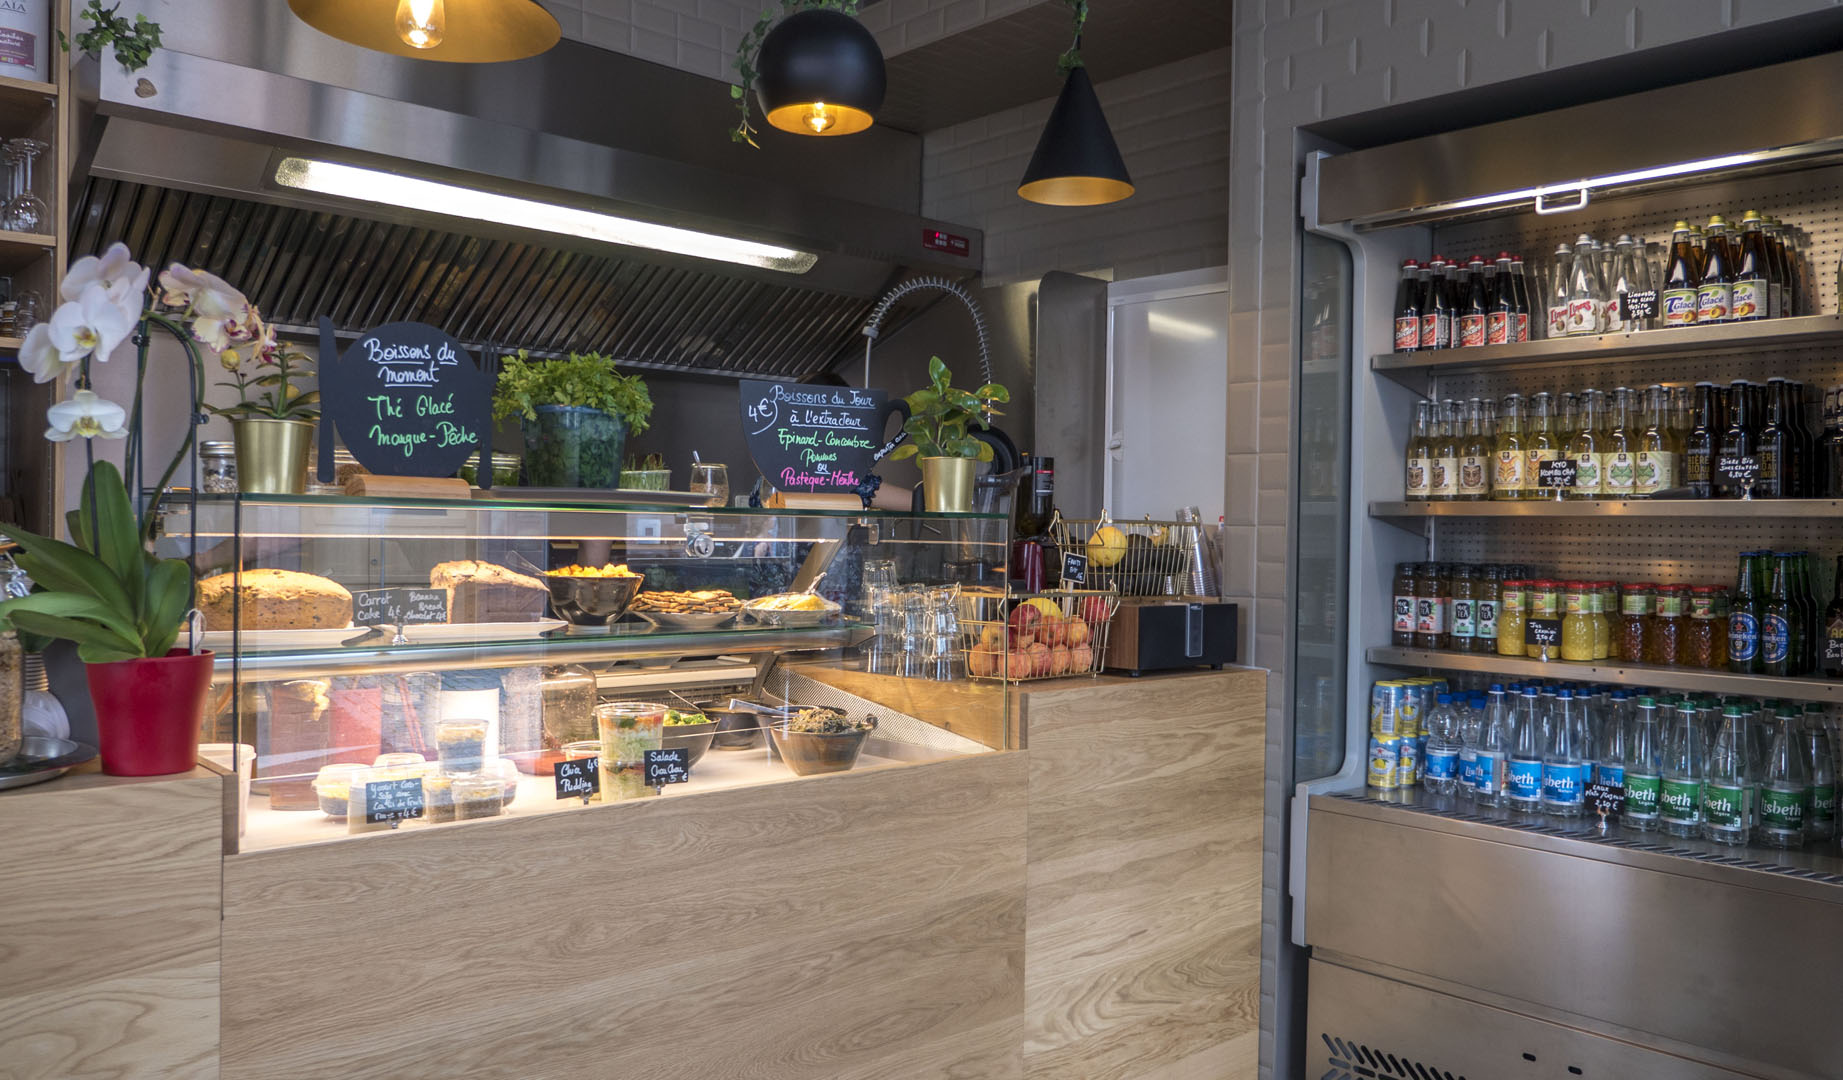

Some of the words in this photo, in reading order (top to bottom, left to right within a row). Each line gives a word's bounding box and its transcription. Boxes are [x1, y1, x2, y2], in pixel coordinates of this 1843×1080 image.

[364, 338, 431, 362] Boissons
[437, 342, 458, 362] du
[769, 385, 826, 404] Boissons
[831, 392, 845, 405] du
[850, 390, 876, 406] Jour
[367, 395, 403, 420] Thé
[416, 393, 454, 416] Glacé
[790, 410, 799, 423] à
[359, 592, 392, 607] Carrot
[358, 608, 381, 620] Cake
[650, 751, 681, 762] Salade
[561, 764, 582, 778] Chia
[1761, 797, 1801, 816] Lisbeth
